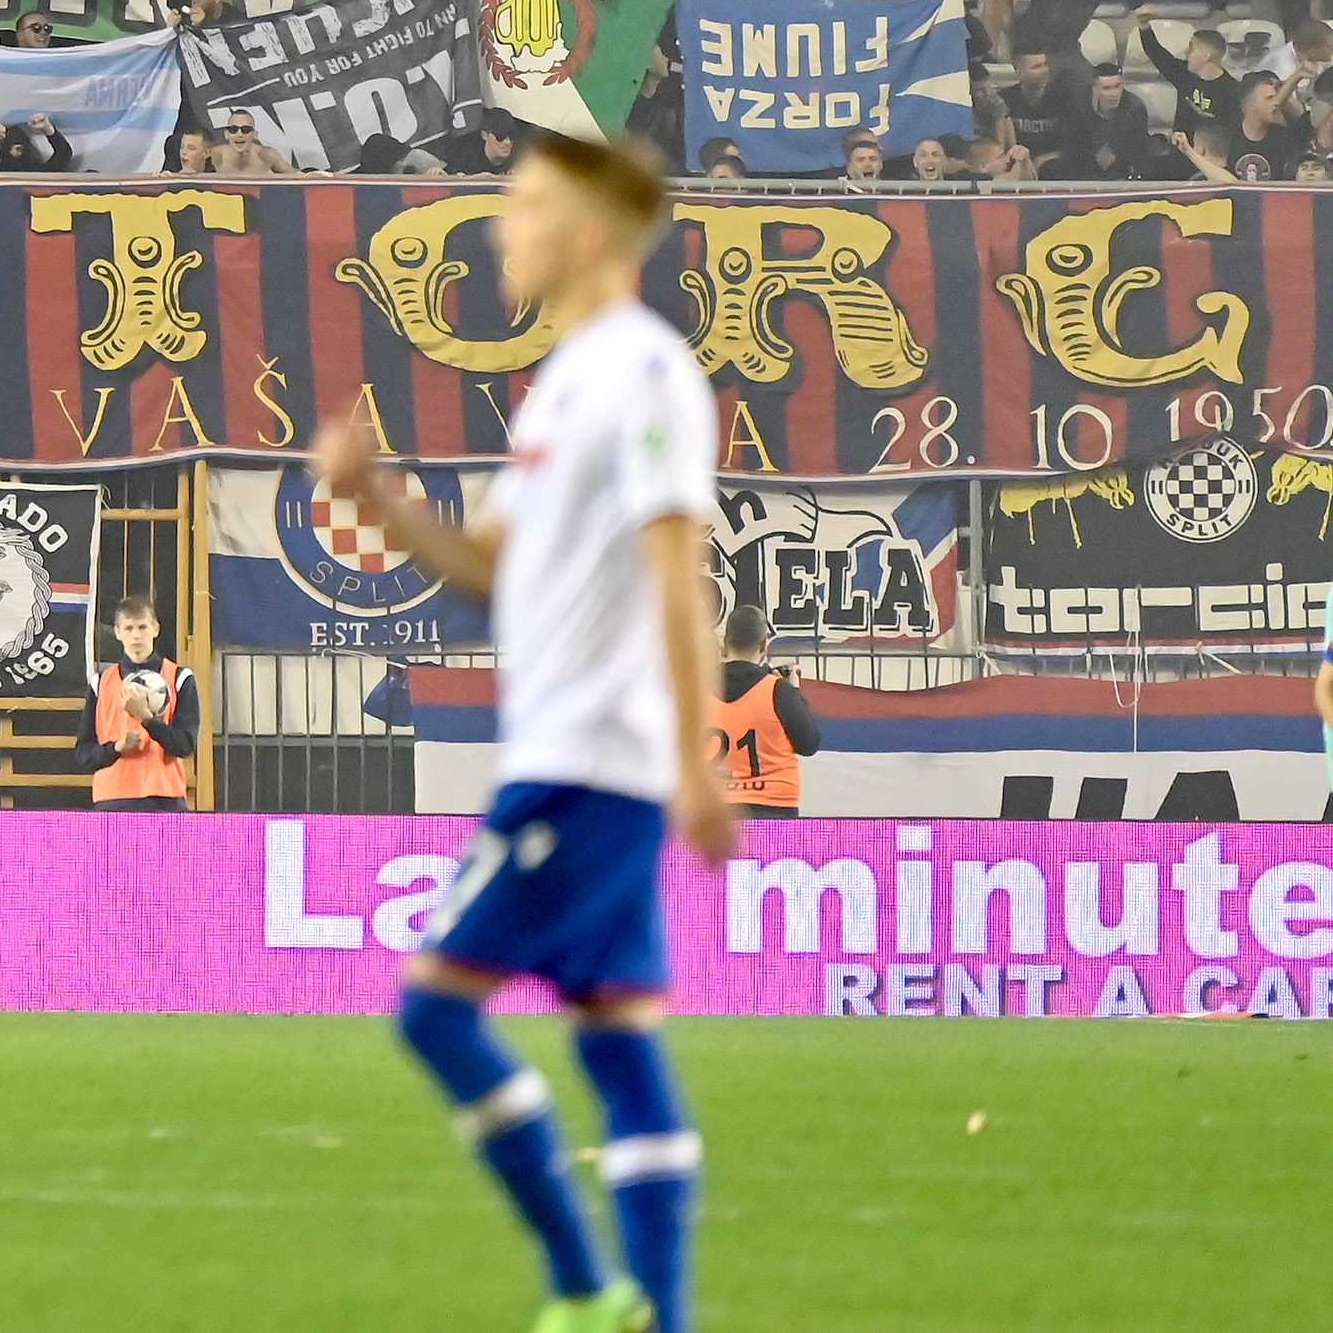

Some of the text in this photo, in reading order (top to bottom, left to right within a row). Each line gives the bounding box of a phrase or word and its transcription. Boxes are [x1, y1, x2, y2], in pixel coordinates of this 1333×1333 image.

[364, 25, 414, 59] FIGHT
[702, 16, 888, 78] FIUME
[284, 61, 326, 89] YOU
[325, 49, 363, 75] FOR
[704, 82, 892, 136] FORZA
[1165, 512, 1234, 537] SPLIT
[309, 559, 429, 604] SPLIT
[310, 619, 441, 647] EST. 1911
[725, 825, 1333, 961] minute
[823, 963, 1064, 1017] RENT
[1093, 964, 1151, 1018] A
